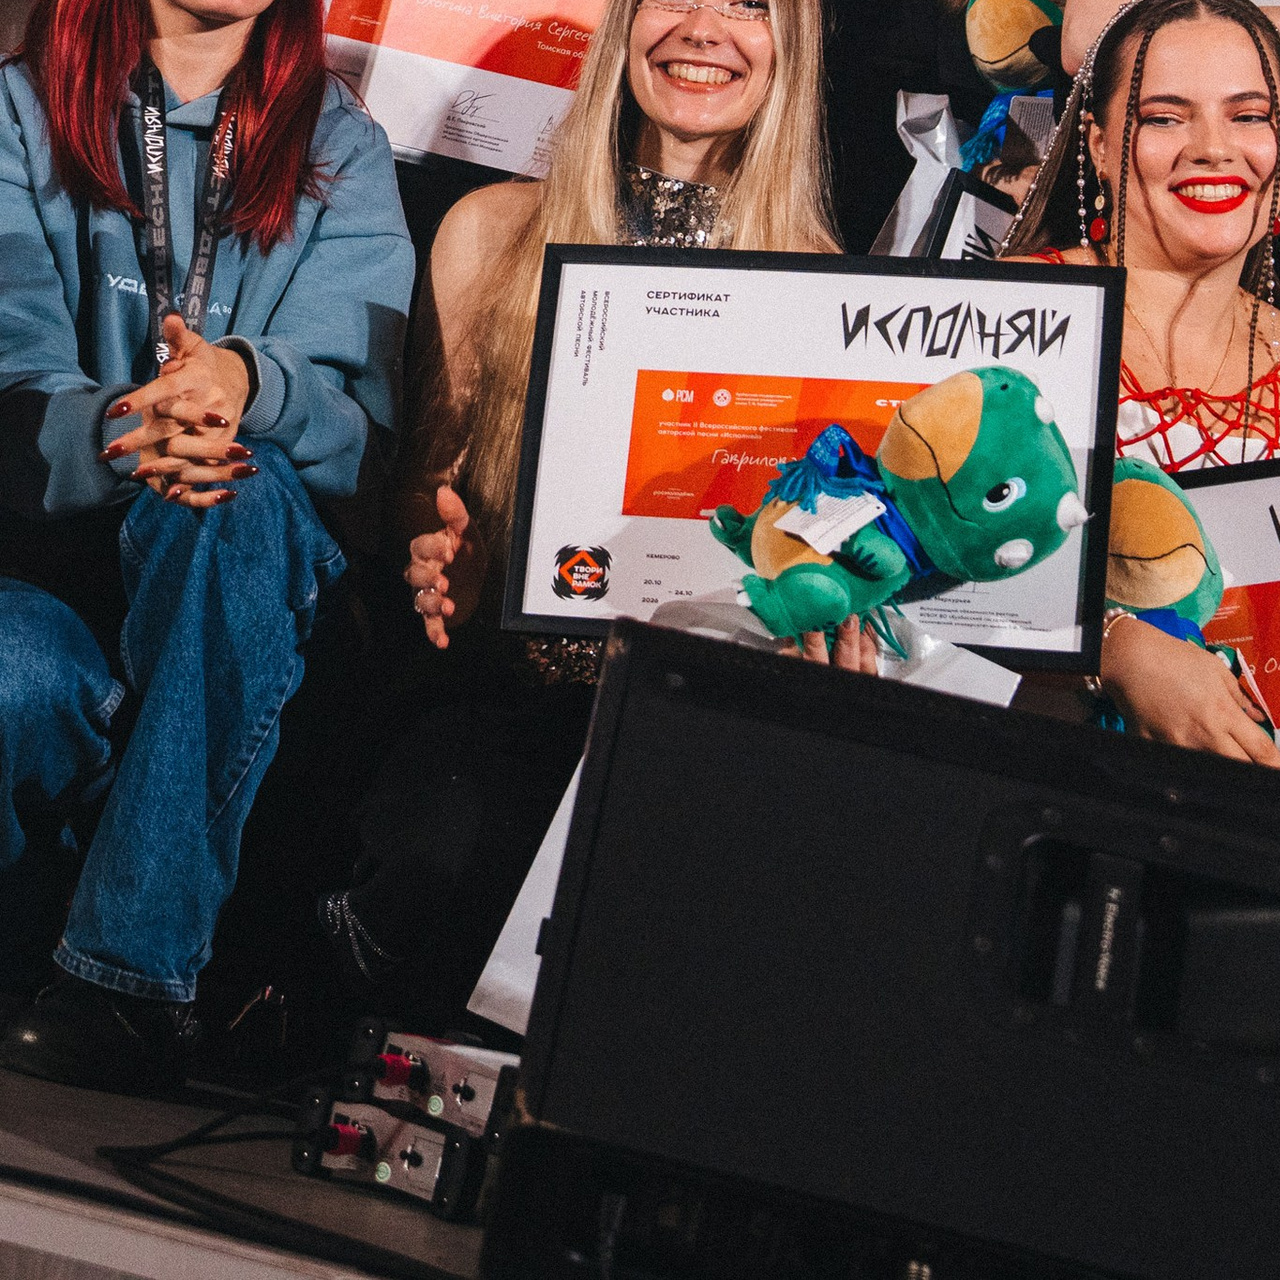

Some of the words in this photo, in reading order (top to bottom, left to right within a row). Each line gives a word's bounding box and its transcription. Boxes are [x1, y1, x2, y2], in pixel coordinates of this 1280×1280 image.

[537, 41, 571, 55] Томская
[144, 106, 164, 174] ИСПОЛНЯЙ
[646, 290, 731, 302] СЕРТИФИКАТ
[645, 306, 720, 318] УЧАСТНИКА
[598, 290, 610, 351] ВСЕРОССИЙСКИЙ
[841, 299, 1071, 360] ИСПОЛНЯЙ
[675, 389, 694, 403] РСМ
[572, 572, 590, 580] ВНЕ
[574, 565, 603, 575] ТВОРИ
[571, 579, 602, 589] РАМОК
[643, 578, 661, 586] 20.10
[675, 589, 693, 597] 24.10
